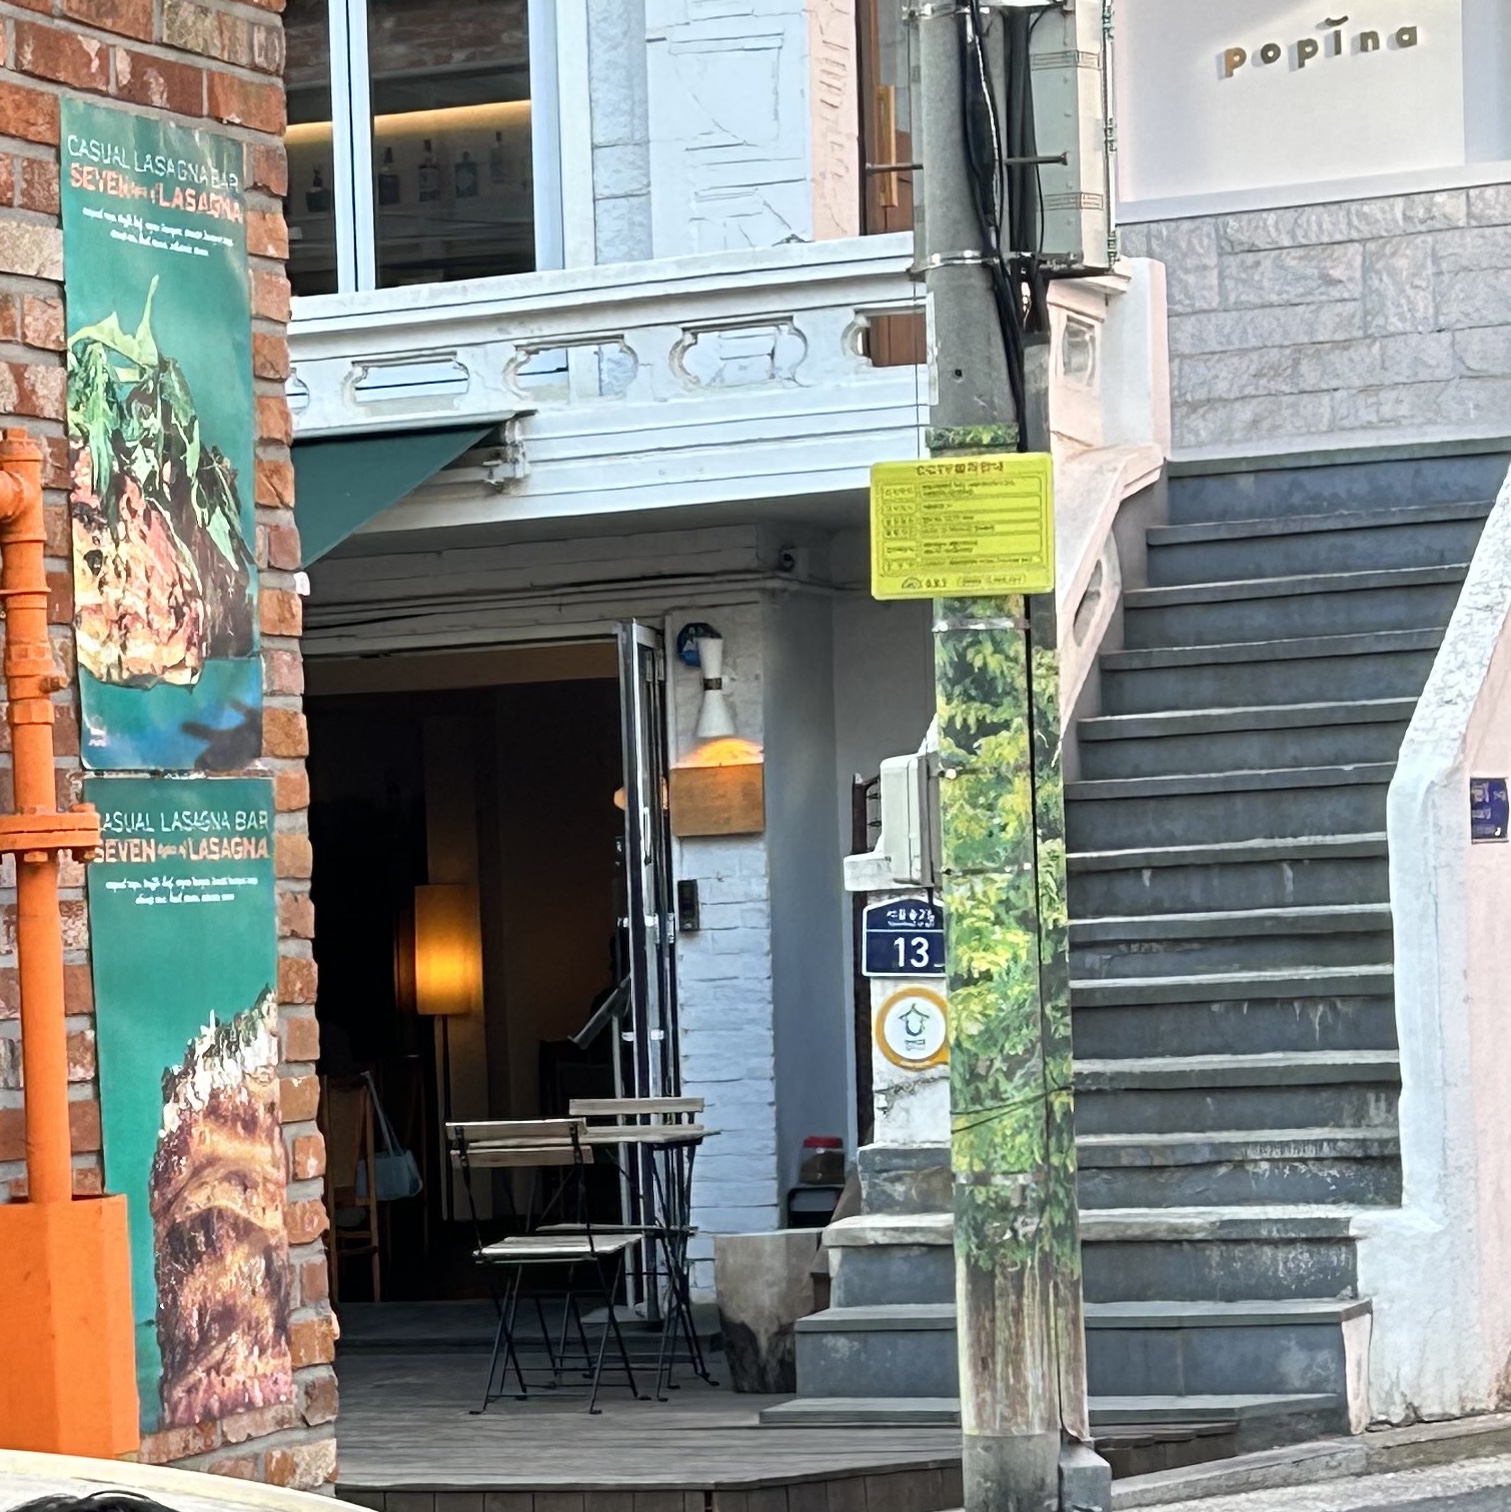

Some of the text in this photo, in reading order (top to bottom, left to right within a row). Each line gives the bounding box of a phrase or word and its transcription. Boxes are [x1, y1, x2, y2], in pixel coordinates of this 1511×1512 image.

[67, 134, 130, 169] CASUAL
[134, 150, 209, 187] LASAGNA
[100, 810, 269, 833] ASUAL LASAGNA BAR
[188, 836, 270, 862] LASAGNA
[893, 936, 929, 968] 13
